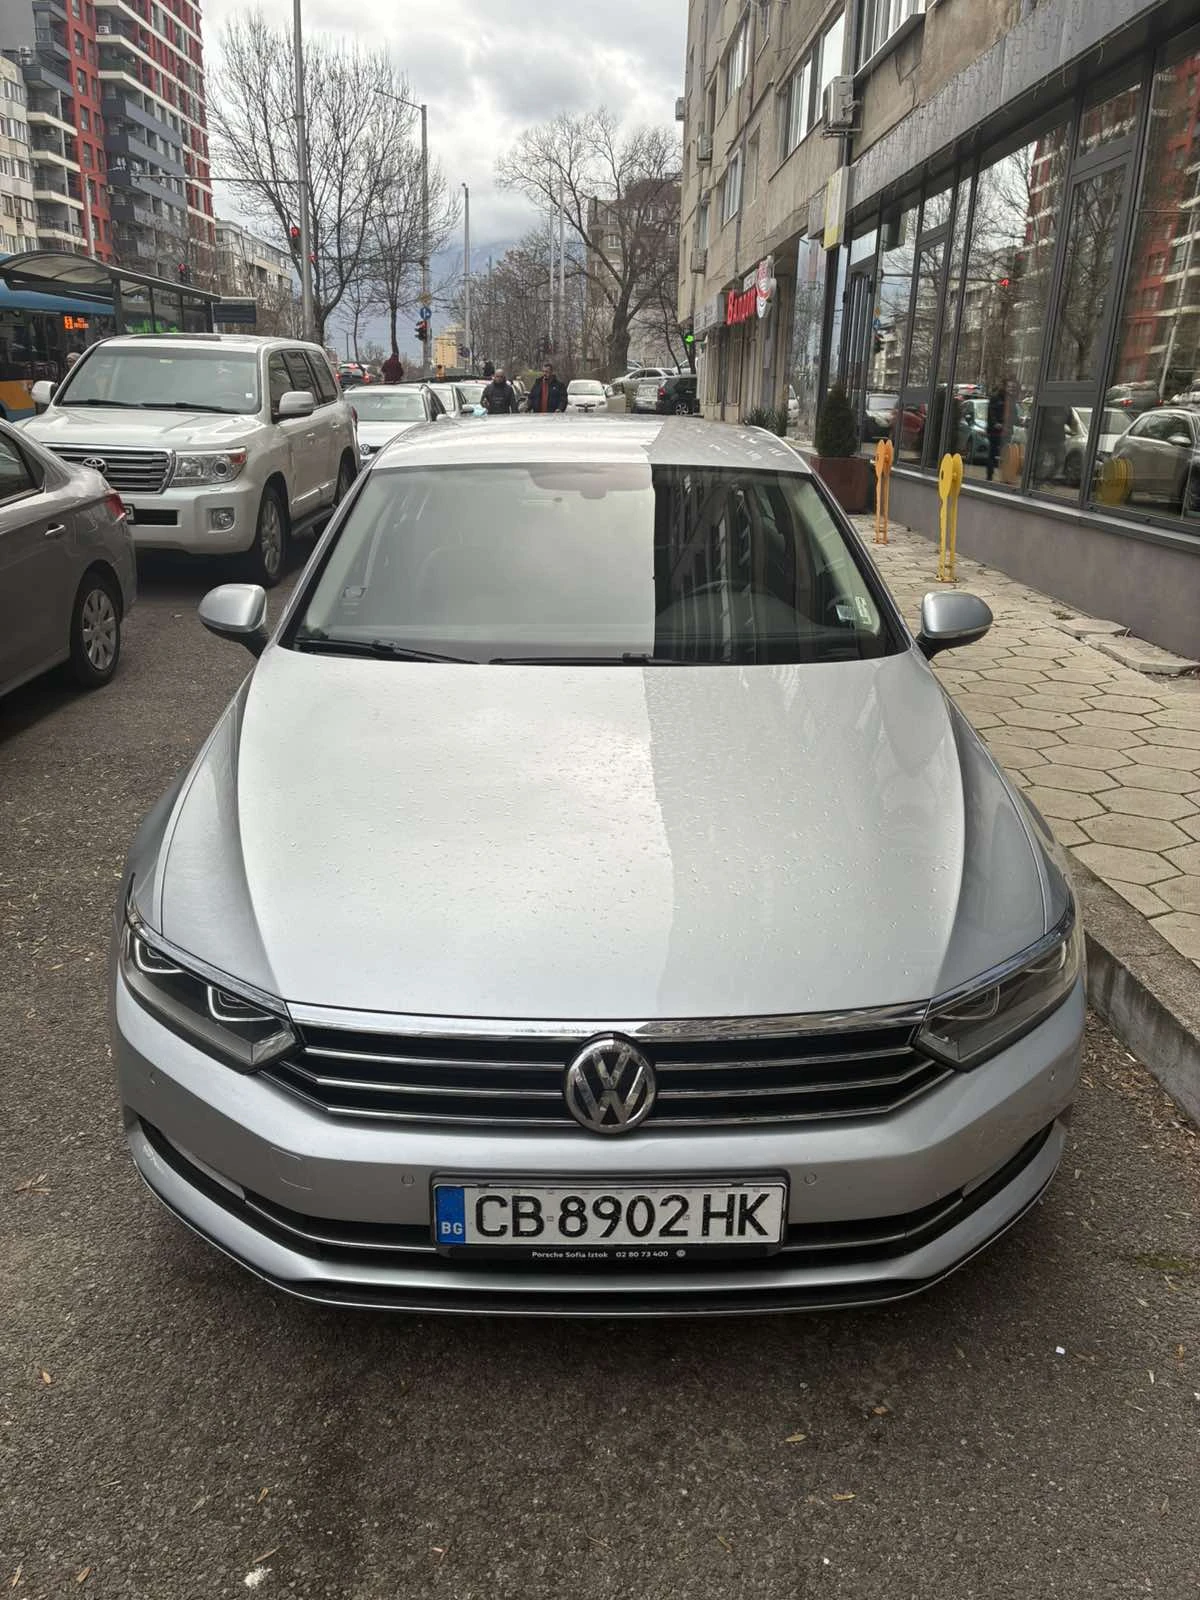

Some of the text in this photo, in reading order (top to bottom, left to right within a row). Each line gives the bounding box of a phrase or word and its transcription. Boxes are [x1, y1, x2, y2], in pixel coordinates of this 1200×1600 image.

[475, 1193, 770, 1239] CB 8902 HK
[441, 1222, 463, 1235] BG
[532, 1250, 563, 1258] Porsche
[565, 1250, 586, 1258] Sofia
[588, 1250, 608, 1258] Iztok
[616, 1250, 626, 1258] 02
[652, 1249, 668, 1257] 400
